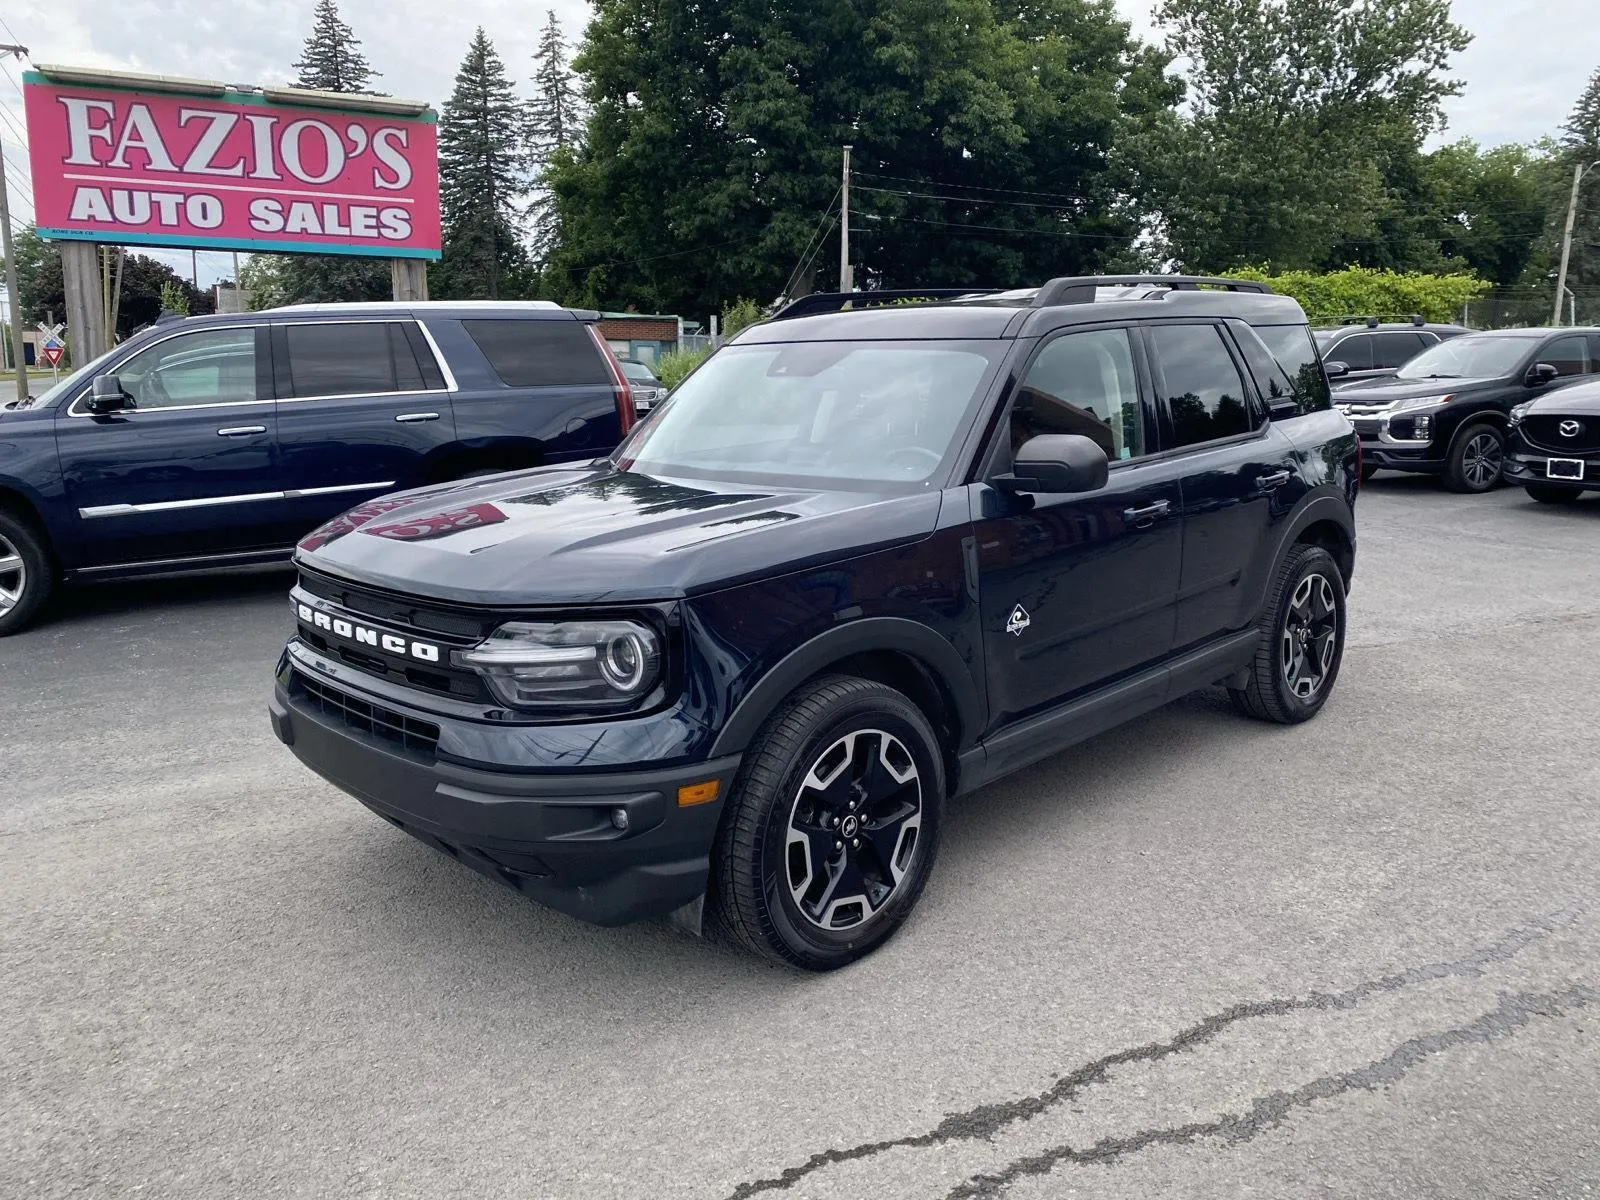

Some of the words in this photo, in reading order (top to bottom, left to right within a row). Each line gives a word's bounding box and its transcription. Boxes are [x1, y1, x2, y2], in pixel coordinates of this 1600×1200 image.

[58, 96, 413, 190] FAZIO'S
[69, 187, 224, 228] AUTO
[249, 199, 412, 240] SALES
[298, 604, 439, 662] BRONCO
